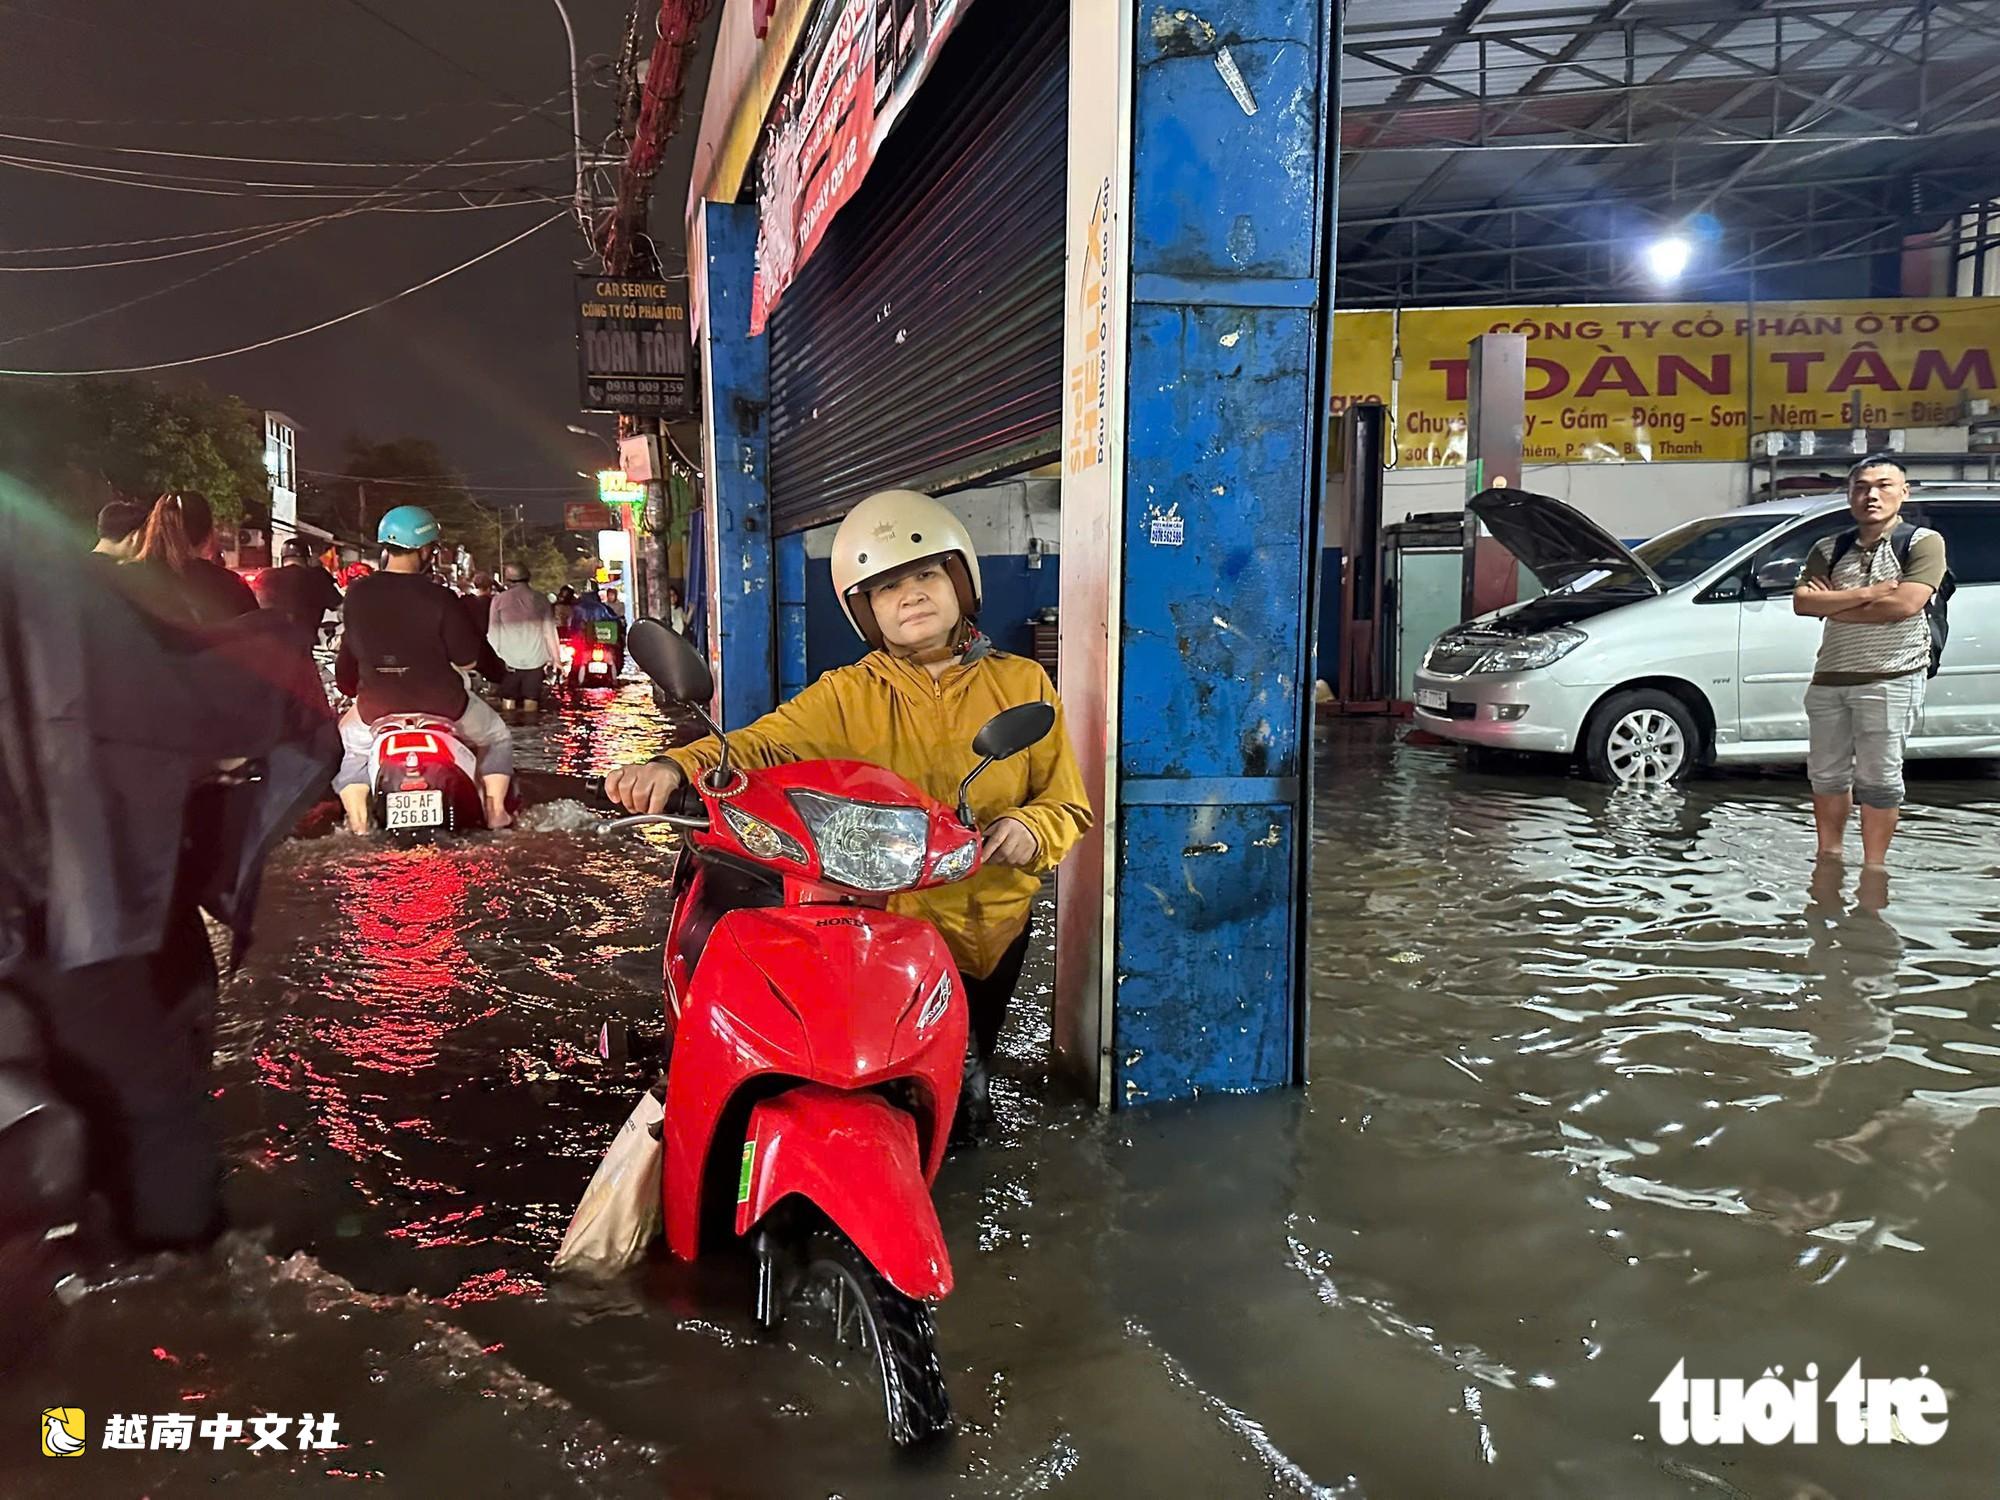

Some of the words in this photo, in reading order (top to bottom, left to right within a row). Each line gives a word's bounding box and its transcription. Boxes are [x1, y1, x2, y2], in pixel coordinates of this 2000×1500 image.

[596, 282, 620, 297] CAR
[622, 283, 667, 299] SERVICE
[609, 304, 621, 318] TY
[1083, 205, 1102, 470] HELIX
[1489, 318, 1604, 340] CÔNG
[1616, 321, 1661, 339] TY
[641, 322, 684, 373] TÂM
[1770, 340, 1998, 394] TÂM
[1070, 364, 1084, 476] Shell
[1406, 411, 1467, 439] Chuyê
[392, 808, 437, 824] 256.81
[816, 917, 873, 931] HONDA
